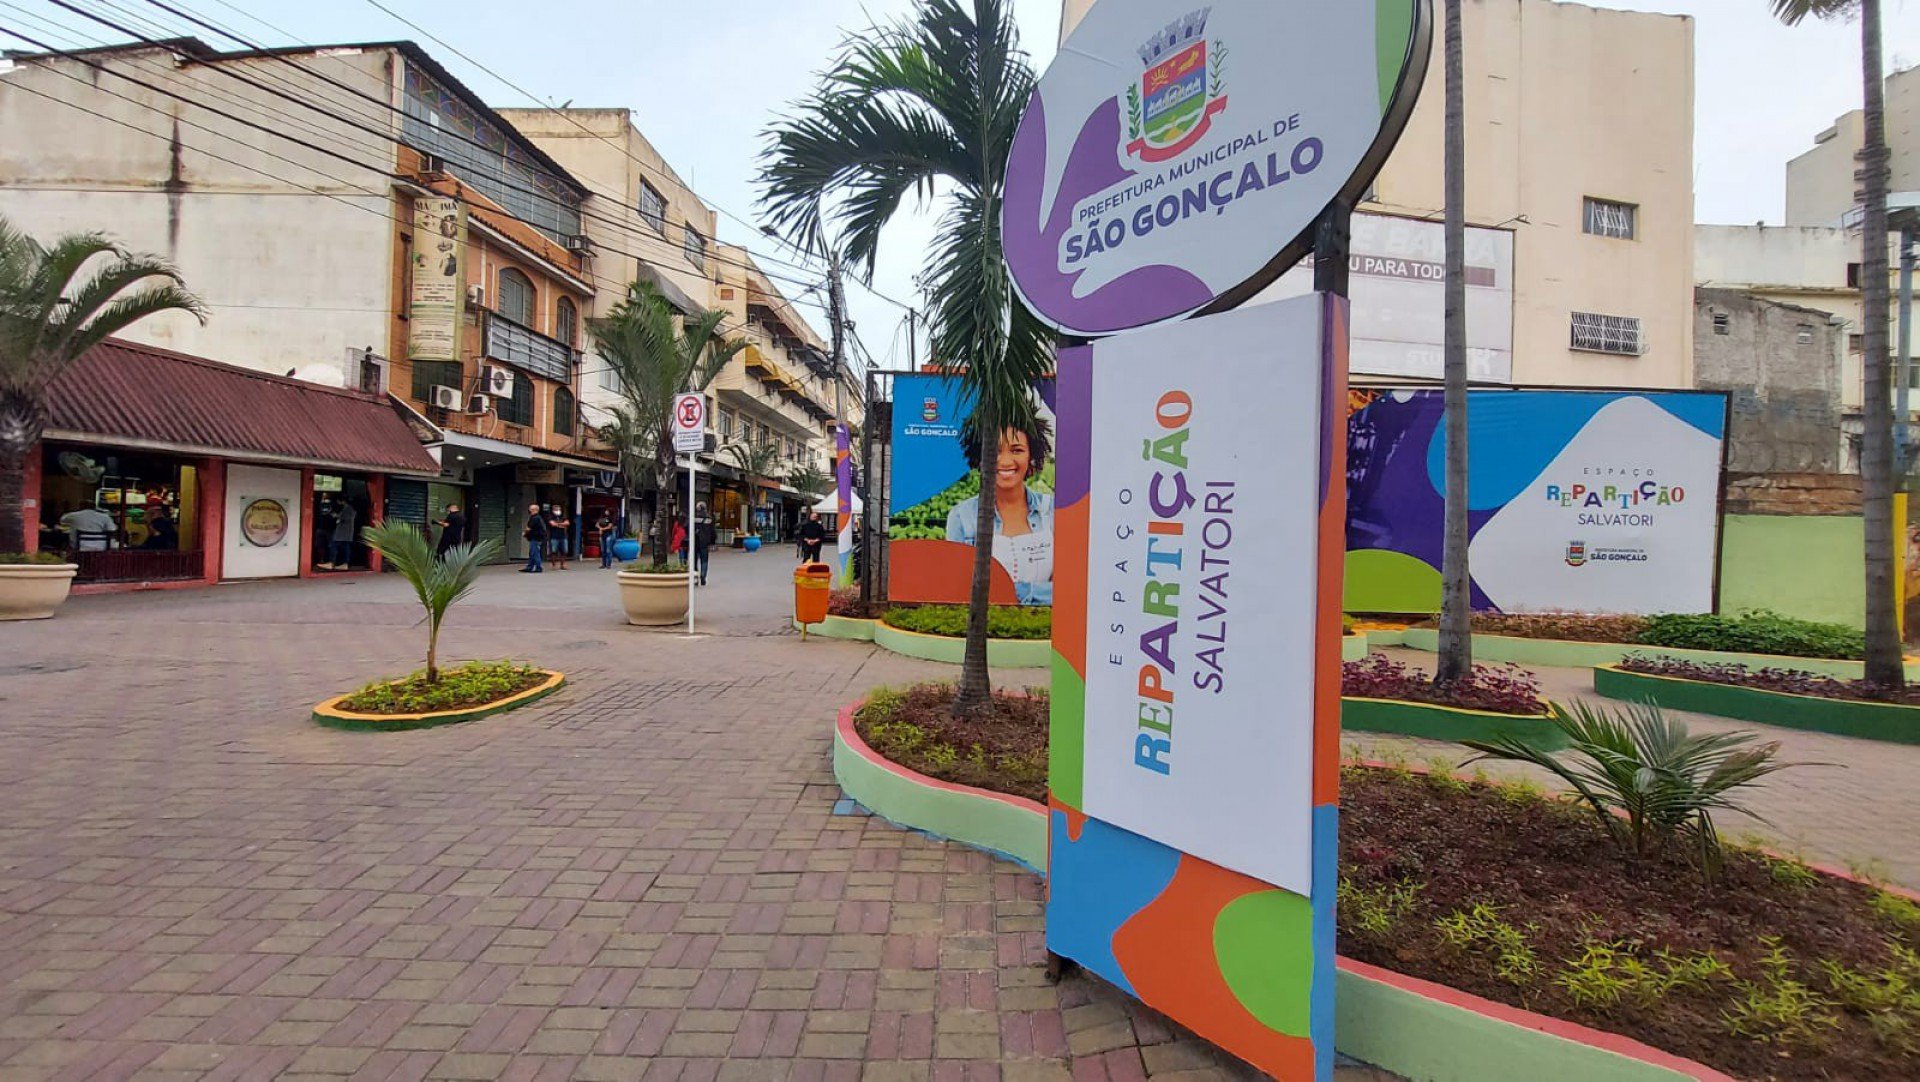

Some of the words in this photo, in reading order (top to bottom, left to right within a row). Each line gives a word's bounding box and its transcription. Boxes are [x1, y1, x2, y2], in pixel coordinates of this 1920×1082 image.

[1065, 220, 1125, 264] SÃO
[1131, 137, 1324, 238] GONÇALO
[1079, 174, 1164, 222] PREFEITURA
[1169, 131, 1268, 186] MUNICIPAL
[1273, 113, 1301, 138] DE
[1365, 258, 1408, 276] PARA
[1411, 263, 1445, 279] TOD
[1546, 480, 1685, 509] REPARTIÇÃO
[1583, 467, 1655, 477] ESPAÇO
[1578, 513, 1654, 526] SALVATORI
[1109, 488, 1134, 665] ESPAÇO
[1134, 390, 1197, 775] REPARTIÇÃO
[1193, 481, 1236, 694] SALVATORI
[1590, 552, 1607, 560] SÃO
